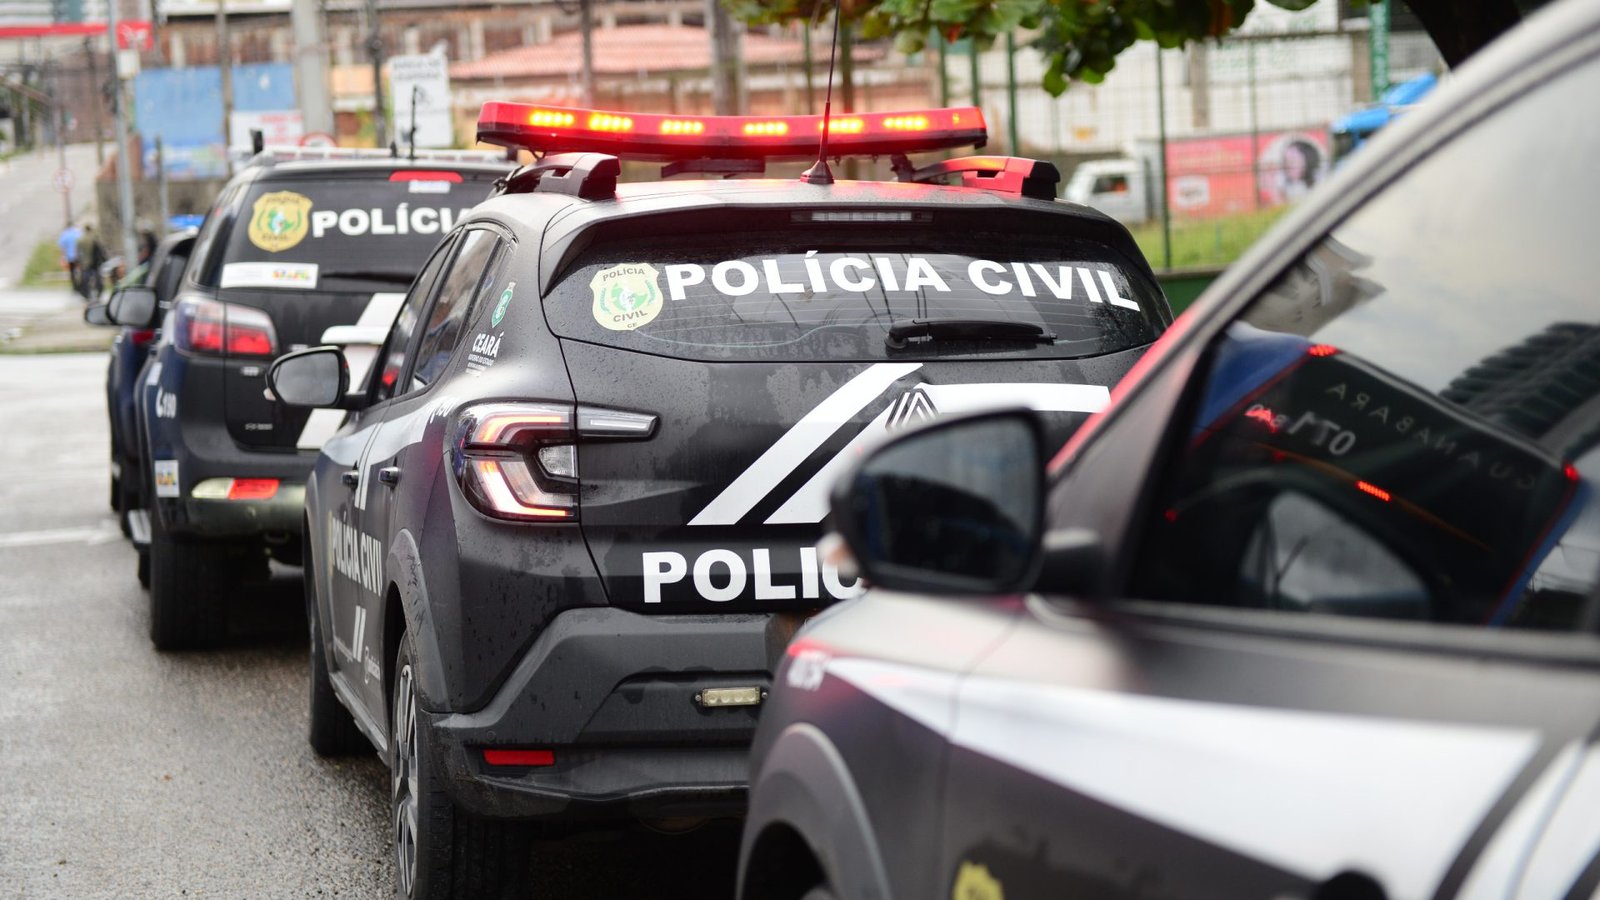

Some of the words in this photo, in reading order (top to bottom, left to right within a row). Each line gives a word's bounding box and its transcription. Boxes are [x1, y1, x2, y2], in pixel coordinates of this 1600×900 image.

[602, 267, 646, 282] POLÍCIA
[664, 250, 951, 300] POLÍCIA
[967, 259, 1141, 312] CIVIL
[613, 310, 648, 322] CIVIL
[472, 331, 505, 358] CEARÁ
[333, 511, 361, 584] POLÍCIA
[361, 532, 383, 597] CIVIL
